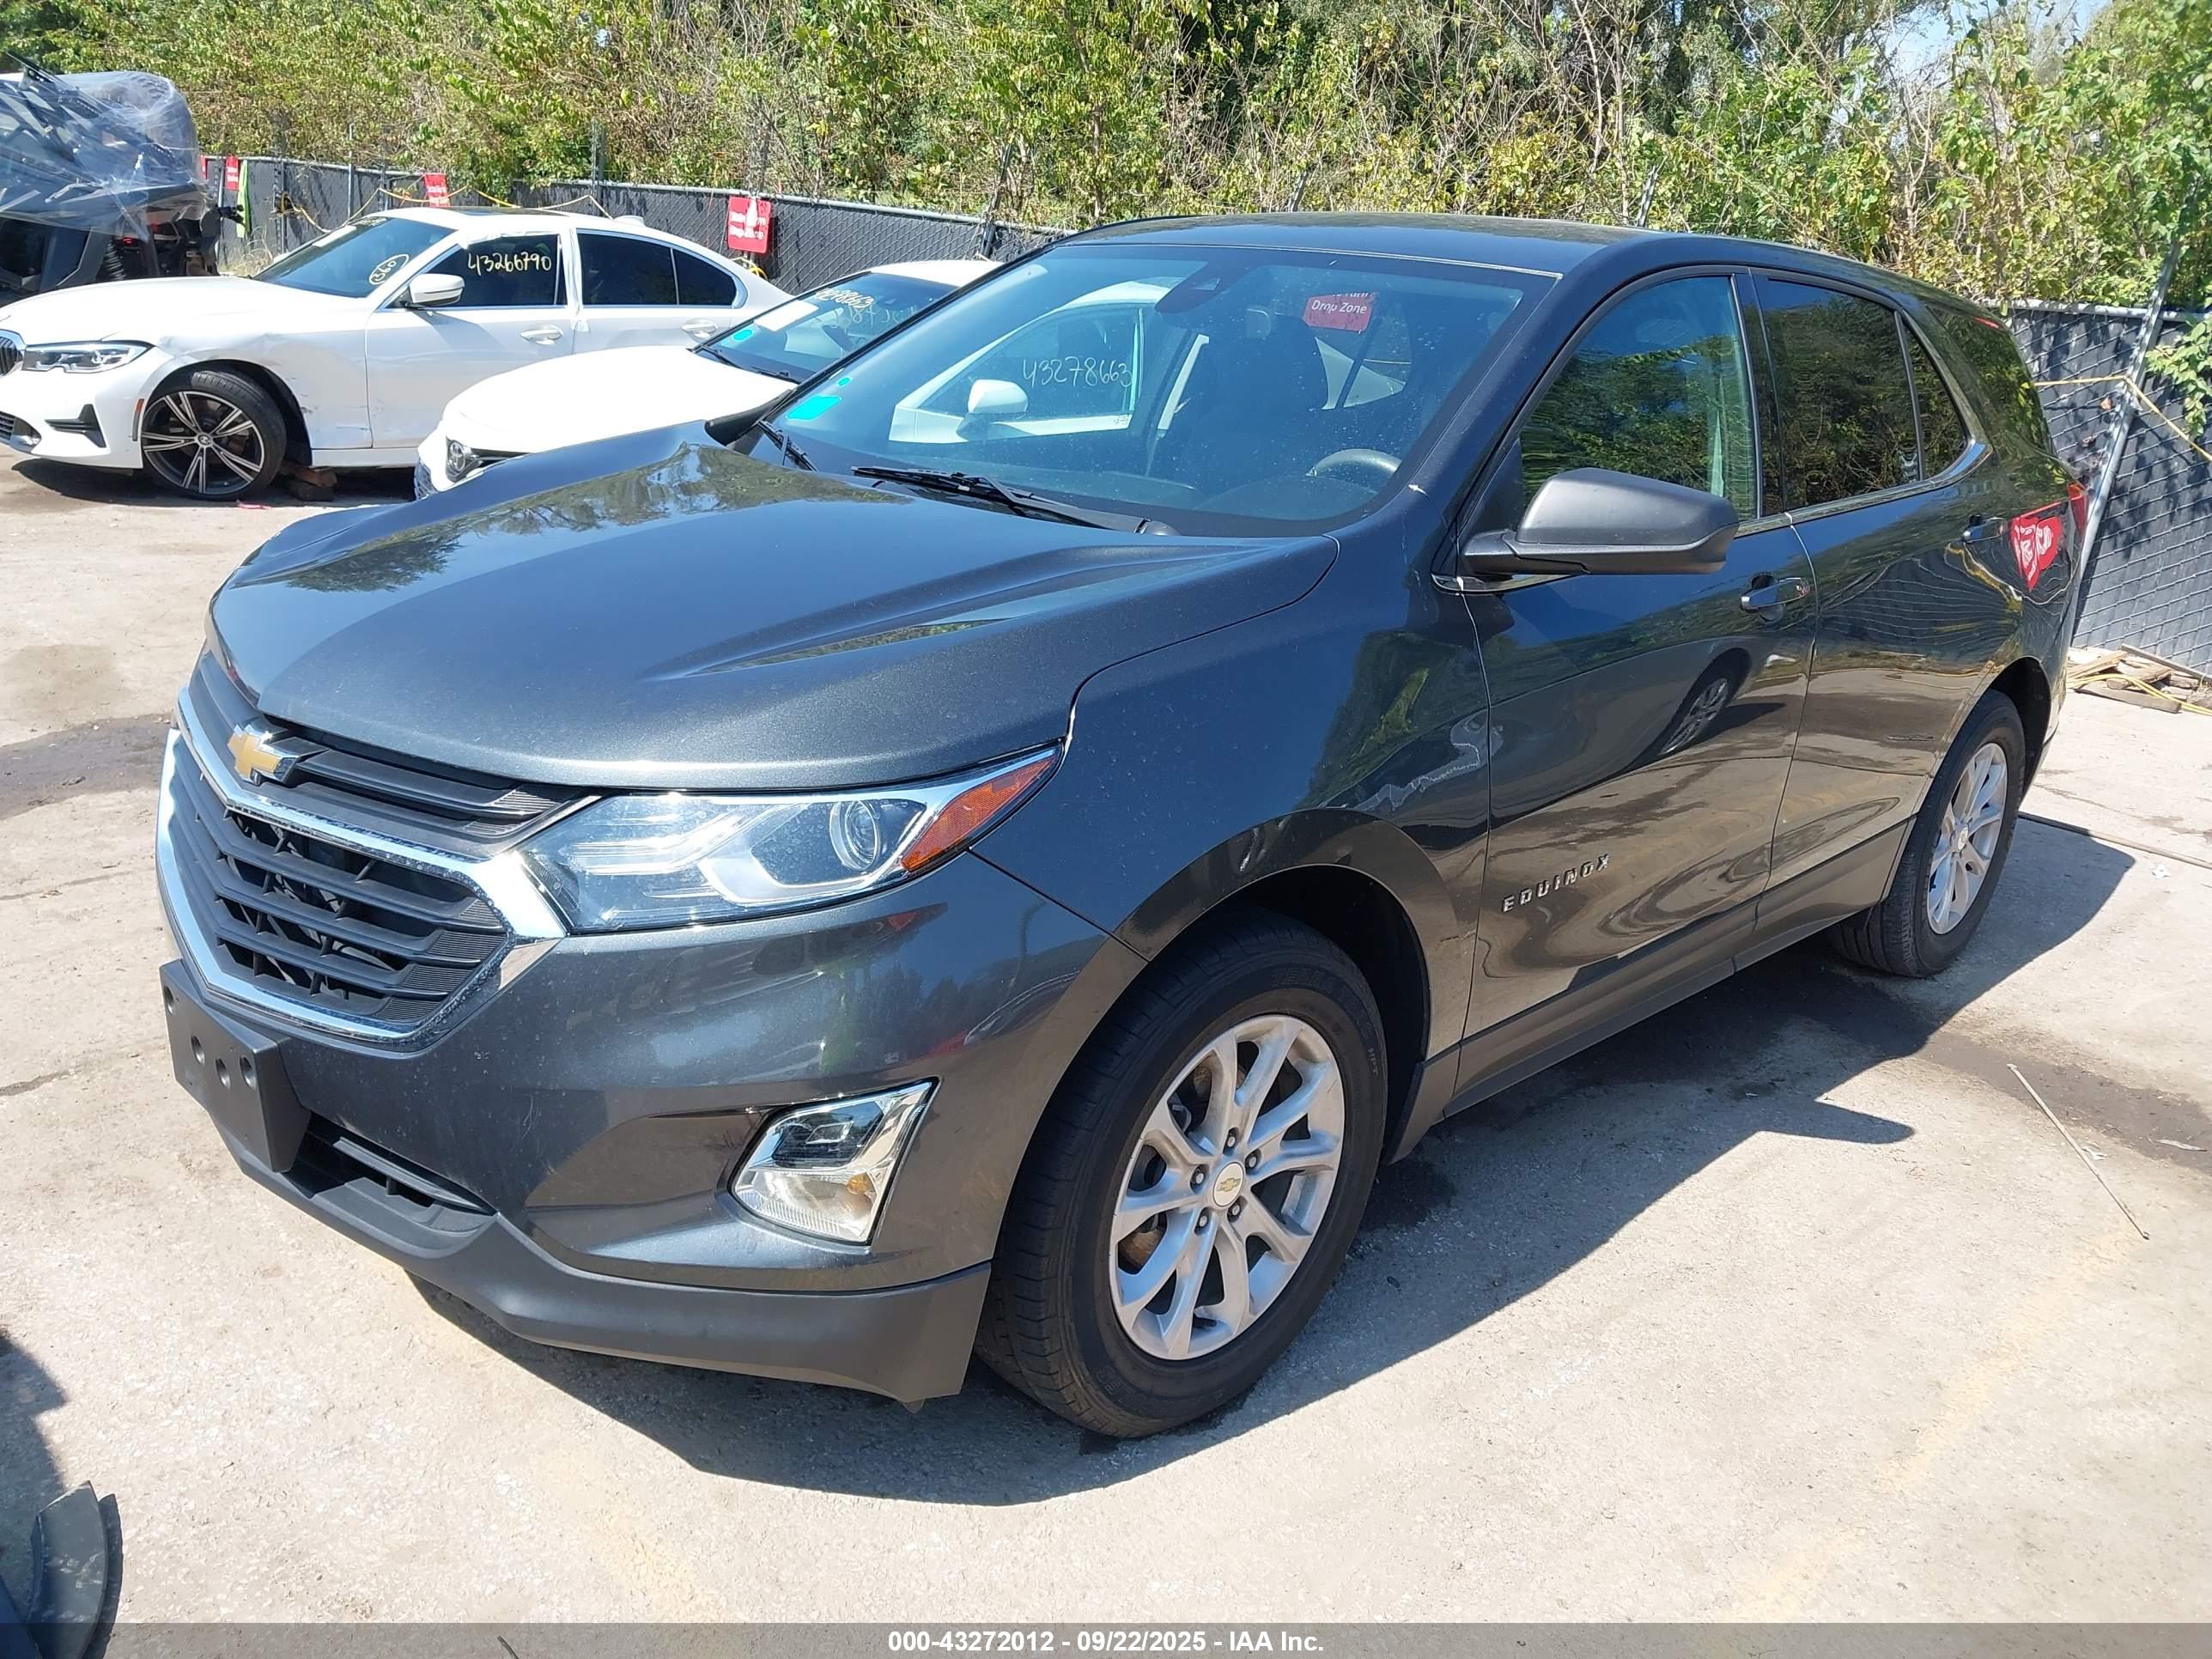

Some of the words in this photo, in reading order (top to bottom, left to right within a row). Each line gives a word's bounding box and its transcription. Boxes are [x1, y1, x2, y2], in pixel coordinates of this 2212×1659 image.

[467, 252, 551, 276] 43266790
[1311, 300, 1337, 313] Drop
[1339, 301, 1367, 313] Zone
[1023, 356, 1133, 387] 43278663
[1502, 854, 1610, 913] EQUINOX
